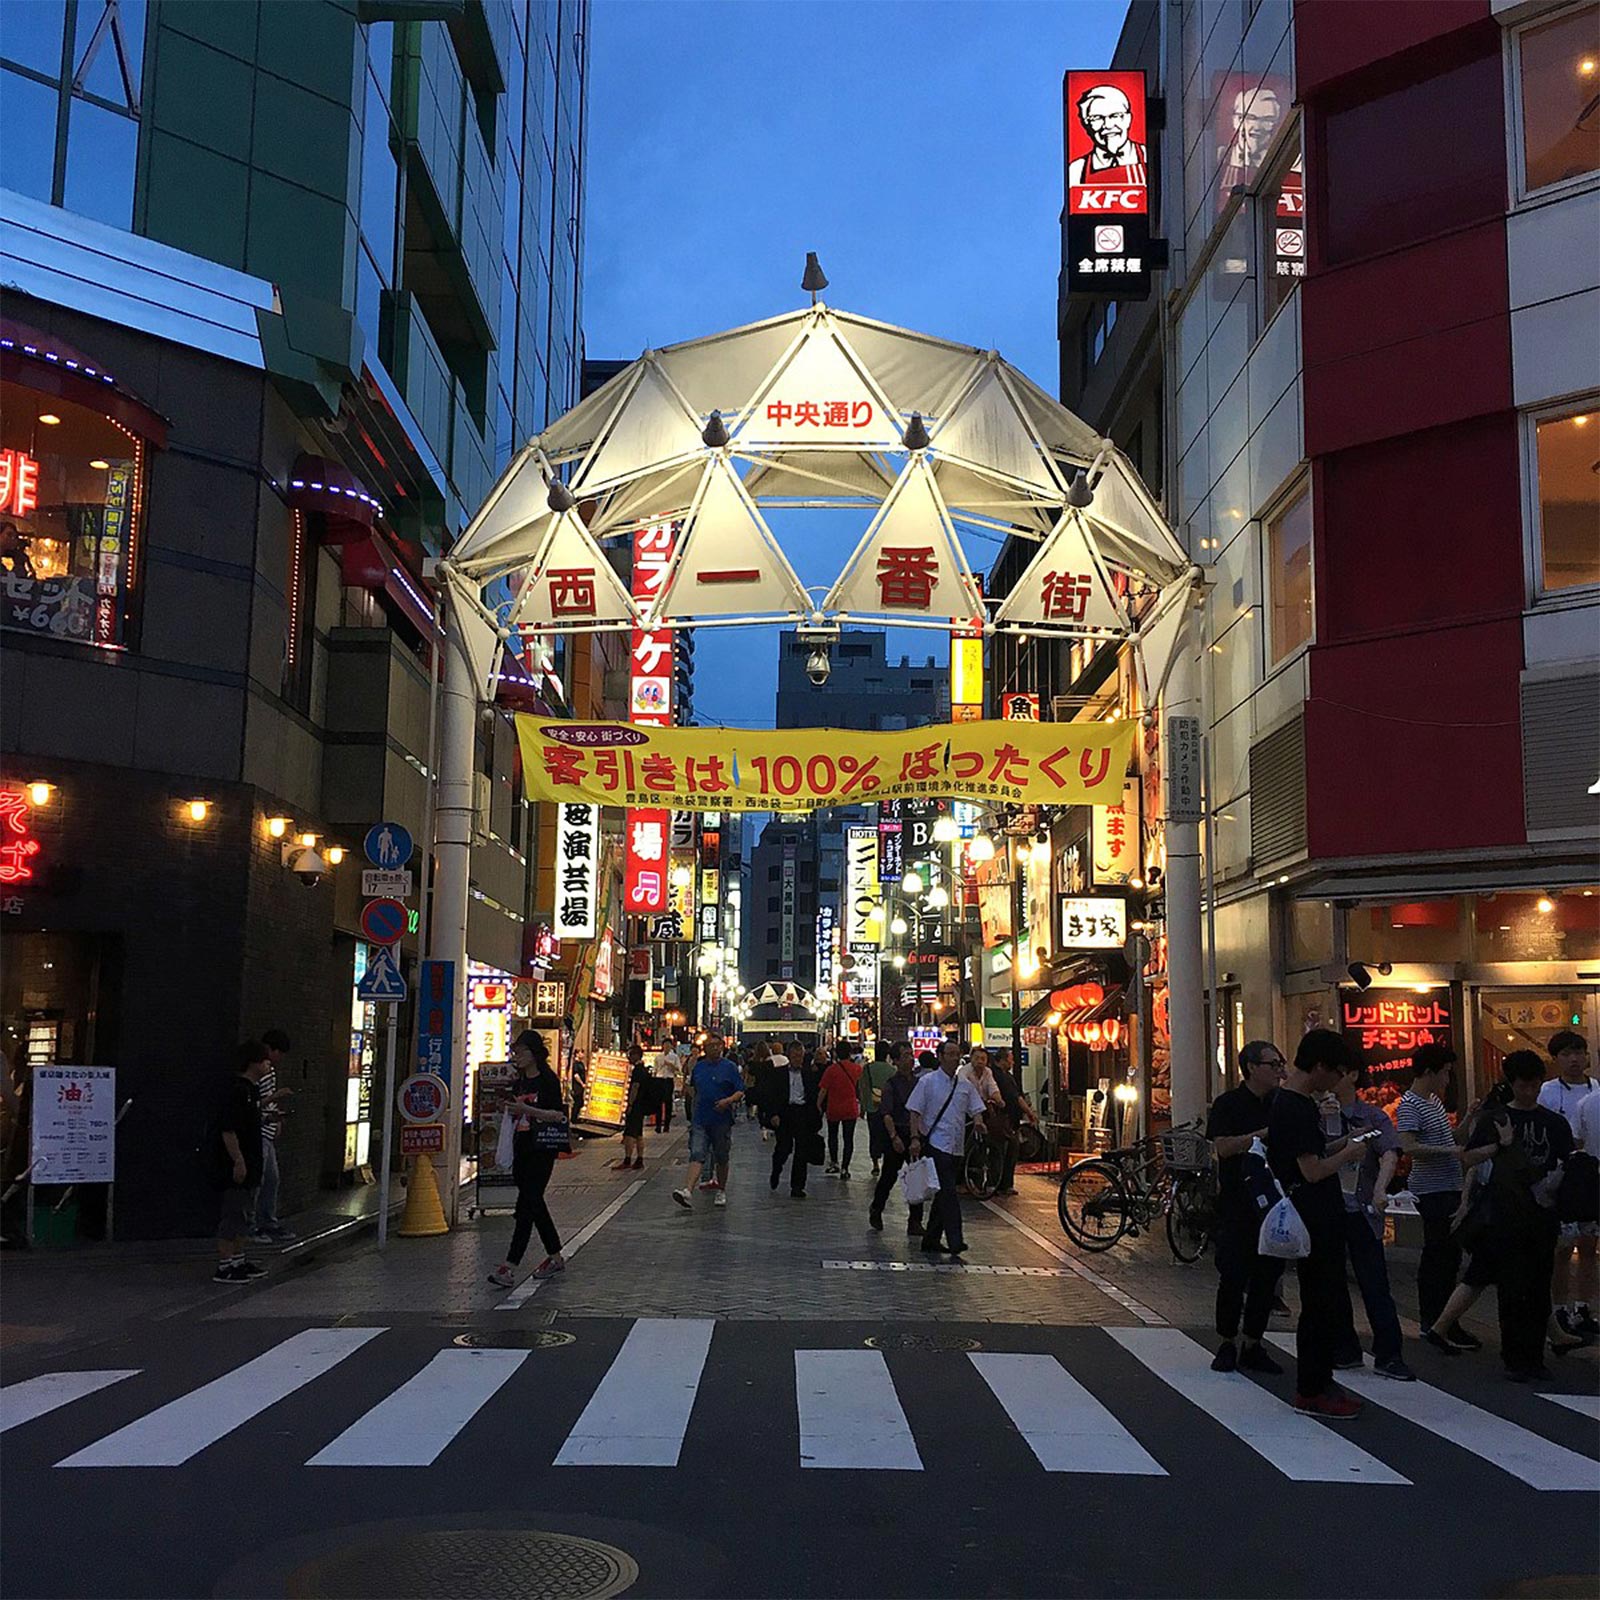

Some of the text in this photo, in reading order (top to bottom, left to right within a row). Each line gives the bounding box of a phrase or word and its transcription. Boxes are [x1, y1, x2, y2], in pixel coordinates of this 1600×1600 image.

[1077, 189, 1144, 210] KFC
[1077, 257, 1142, 274] 全席禁煙
[767, 400, 874, 428] 中央通り
[548, 728, 642, 744] 安全・安心 街づくり
[542, 744, 730, 793] 客引きは
[751, 754, 881, 796] 100%
[899, 741, 1112, 789] ぼったくり
[852, 829, 877, 839] HOTEL
[1344, 1001, 1449, 1024] レッドホット
